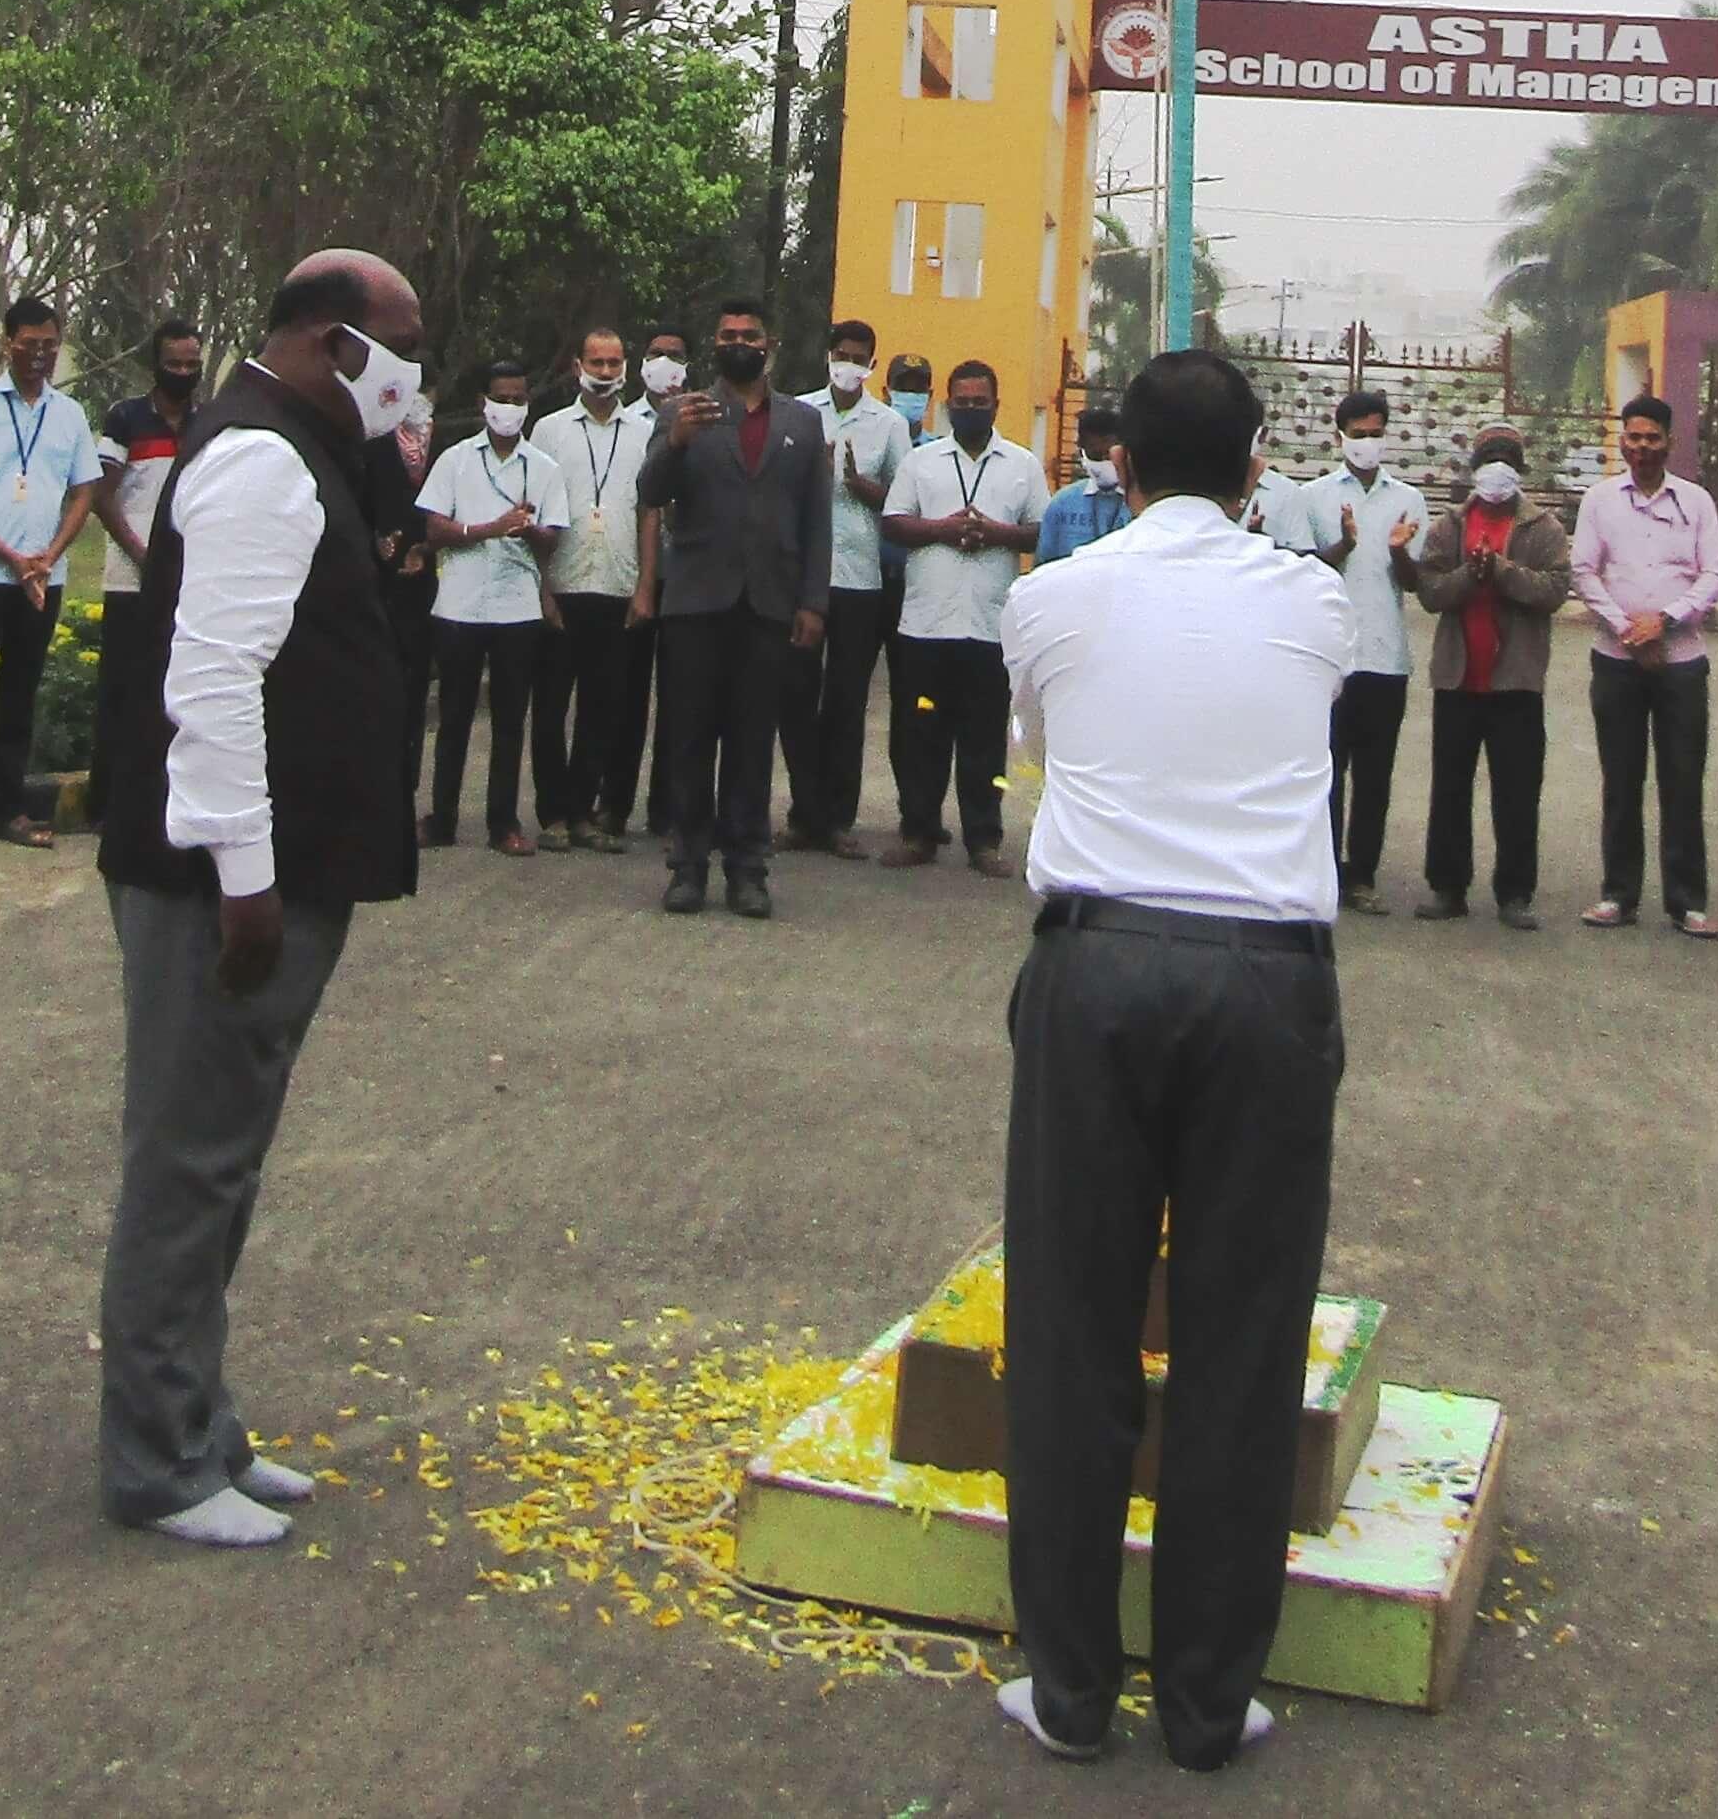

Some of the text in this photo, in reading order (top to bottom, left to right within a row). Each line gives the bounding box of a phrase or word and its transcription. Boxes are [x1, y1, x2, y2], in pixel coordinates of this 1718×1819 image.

[1366, 14, 1668, 63] ASTHA
[1194, 49, 1386, 92] School
[1399, 61, 1456, 95] of
